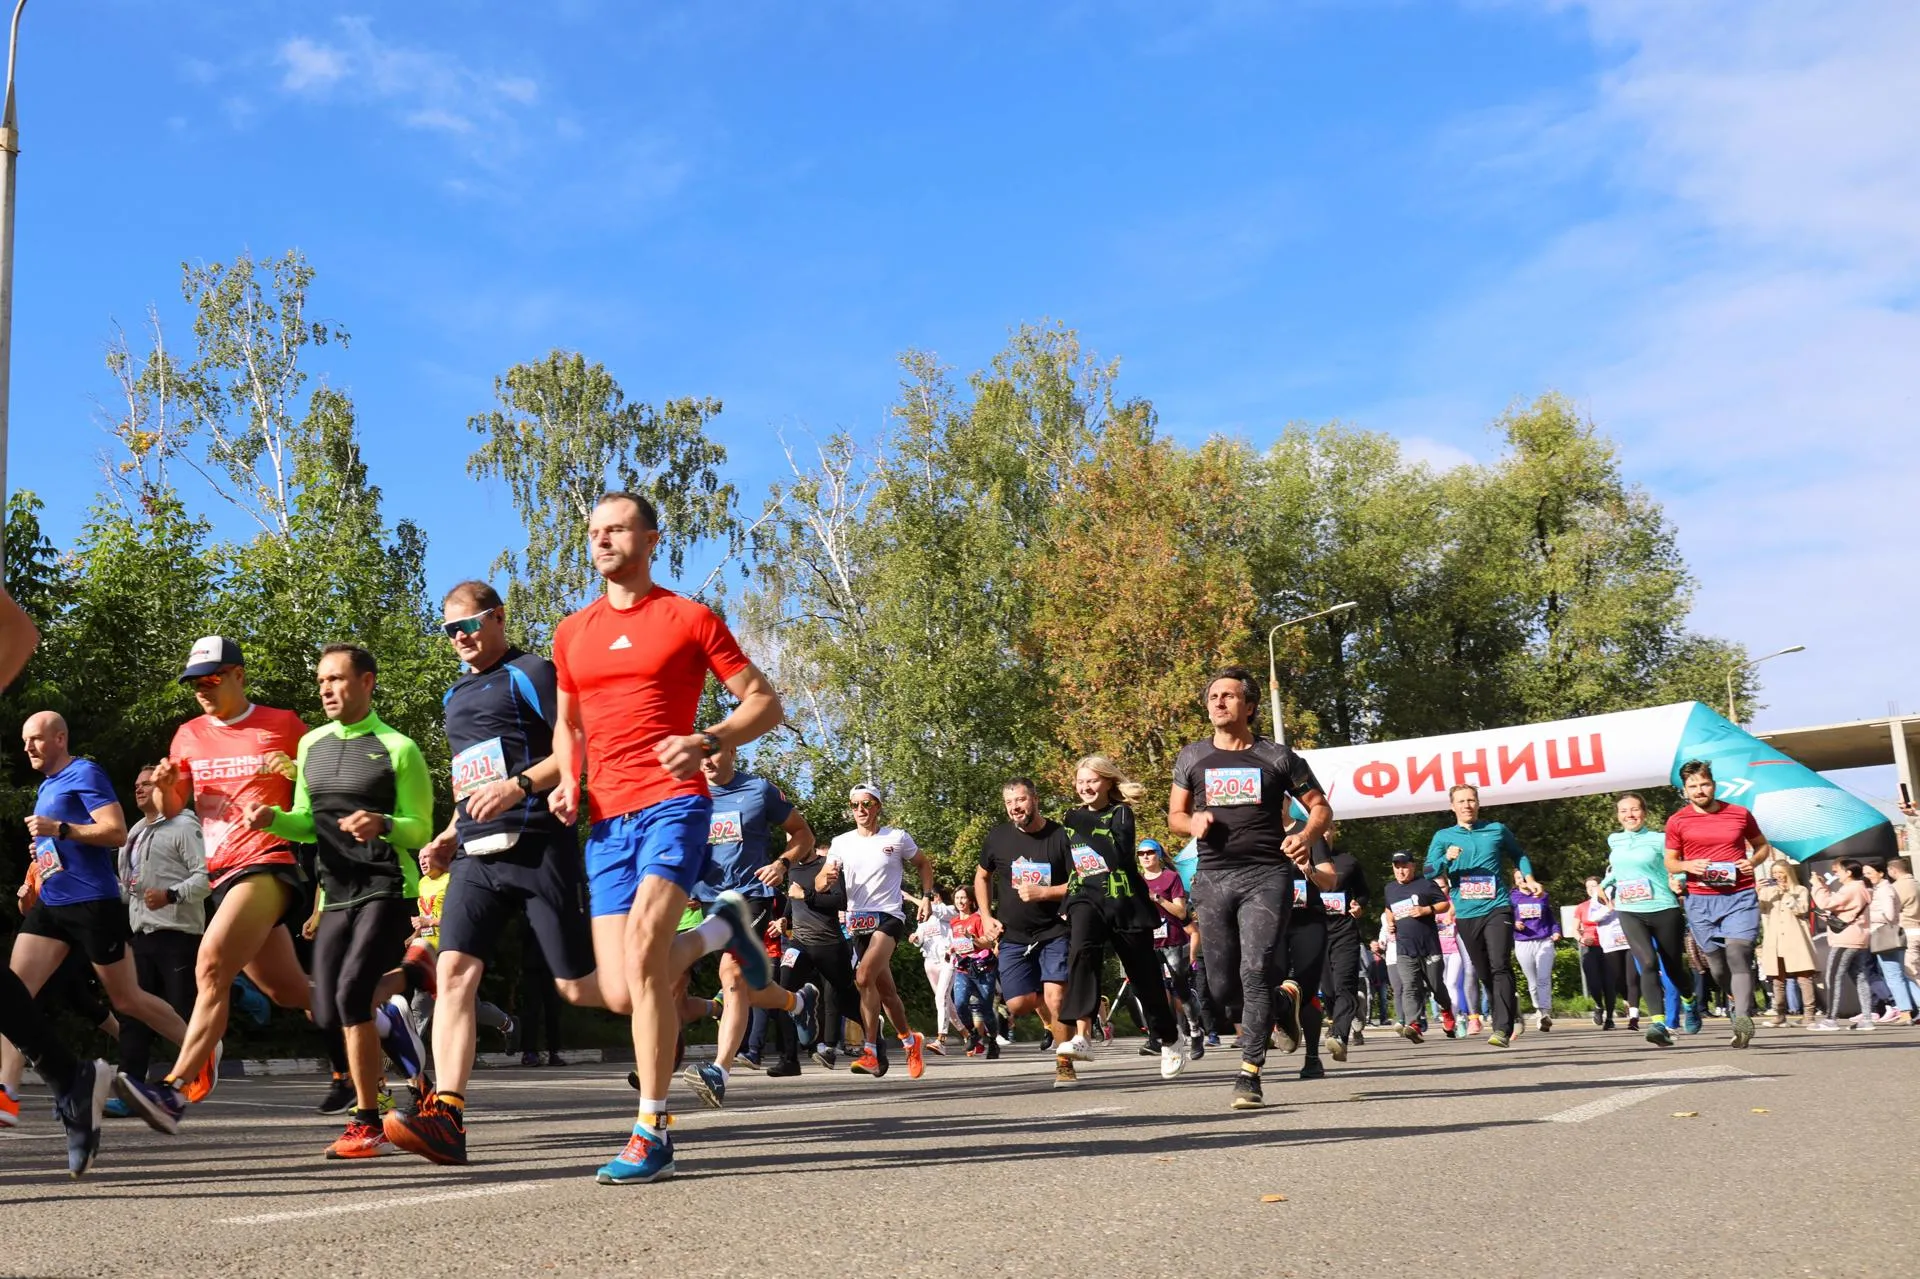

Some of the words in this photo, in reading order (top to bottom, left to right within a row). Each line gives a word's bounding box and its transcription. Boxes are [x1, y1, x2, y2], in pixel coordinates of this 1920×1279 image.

[460, 755, 497, 786] 211
[1353, 733, 1606, 798] ФИНИШ
[1212, 777, 1256, 797] 204
[1080, 854, 1100, 871] 58
[1021, 870, 1042, 885] 59
[850, 914, 876, 929] 220
